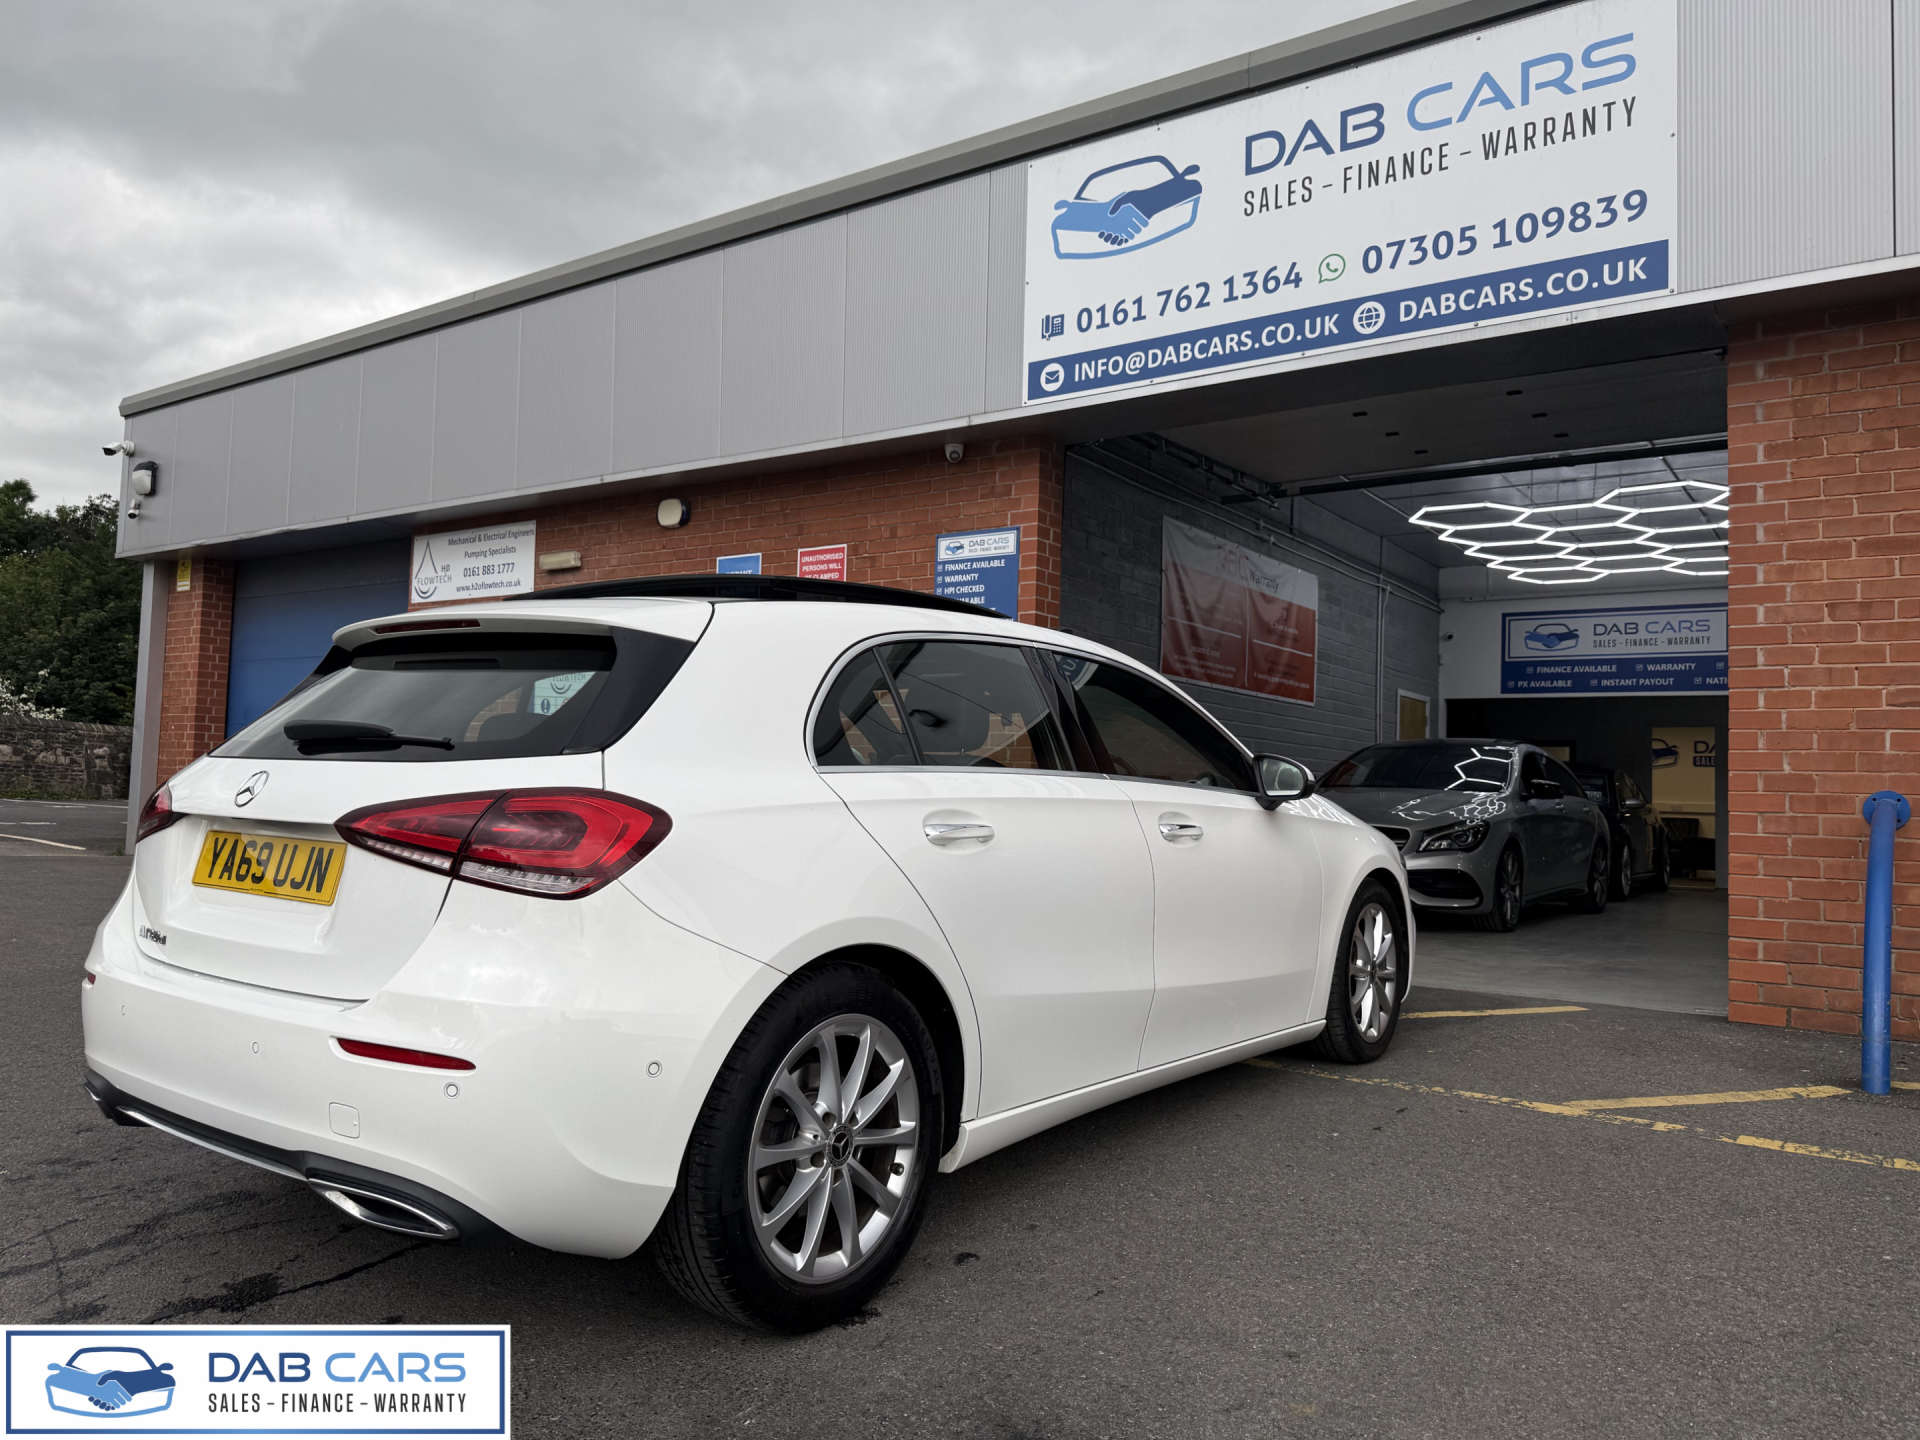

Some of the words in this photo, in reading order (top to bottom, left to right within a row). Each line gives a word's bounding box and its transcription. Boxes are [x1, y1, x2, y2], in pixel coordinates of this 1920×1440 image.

[1245, 102, 1385, 176] DAB
[1406, 32, 1636, 131] CARS
[1243, 176, 1313, 217] SALES
[1343, 142, 1450, 194] FINANCE
[1481, 96, 1636, 160] WARRANTY
[1076, 296, 1147, 333] 0161
[1156, 282, 1211, 317] 762
[1223, 262, 1303, 303] 1364
[1362, 224, 1478, 274] 07305
[1492, 189, 1648, 249] 109839
[1074, 313, 1339, 382] INFO@DABCARS.CO.UK
[1399, 256, 1648, 323] DABCARS.CO.UK
[448, 537, 477, 546] Mechanical
[987, 536, 1010, 545] CARS
[464, 549, 488, 560] Pumping
[488, 545, 517, 557] Specialists
[463, 566, 480, 578] 0161
[482, 564, 495, 576] 883
[497, 561, 515, 574] 1777
[945, 562, 971, 572] FINANCE
[972, 559, 1006, 568] AVAILABLE
[417, 574, 452, 586] FLOWTECH
[944, 573, 979, 583] WARRANTY
[956, 584, 985, 594] CHECKED
[1593, 622, 1639, 637] DAB
[1645, 618, 1711, 634] CARS
[1593, 639, 1617, 649] SALES
[1625, 637, 1659, 648] FINANCE
[1667, 635, 1711, 646] WARRANTY
[1537, 666, 1573, 674] FINANCE
[1573, 664, 1617, 673] AVAILABLE
[1647, 662, 1696, 671] WARRANTY
[1530, 679, 1573, 687] AVAILABLE
[1602, 678, 1637, 686] INSTANT
[1639, 677, 1675, 686] PAYOUT
[208, 836, 274, 884] YA69
[273, 845, 334, 893] UJN
